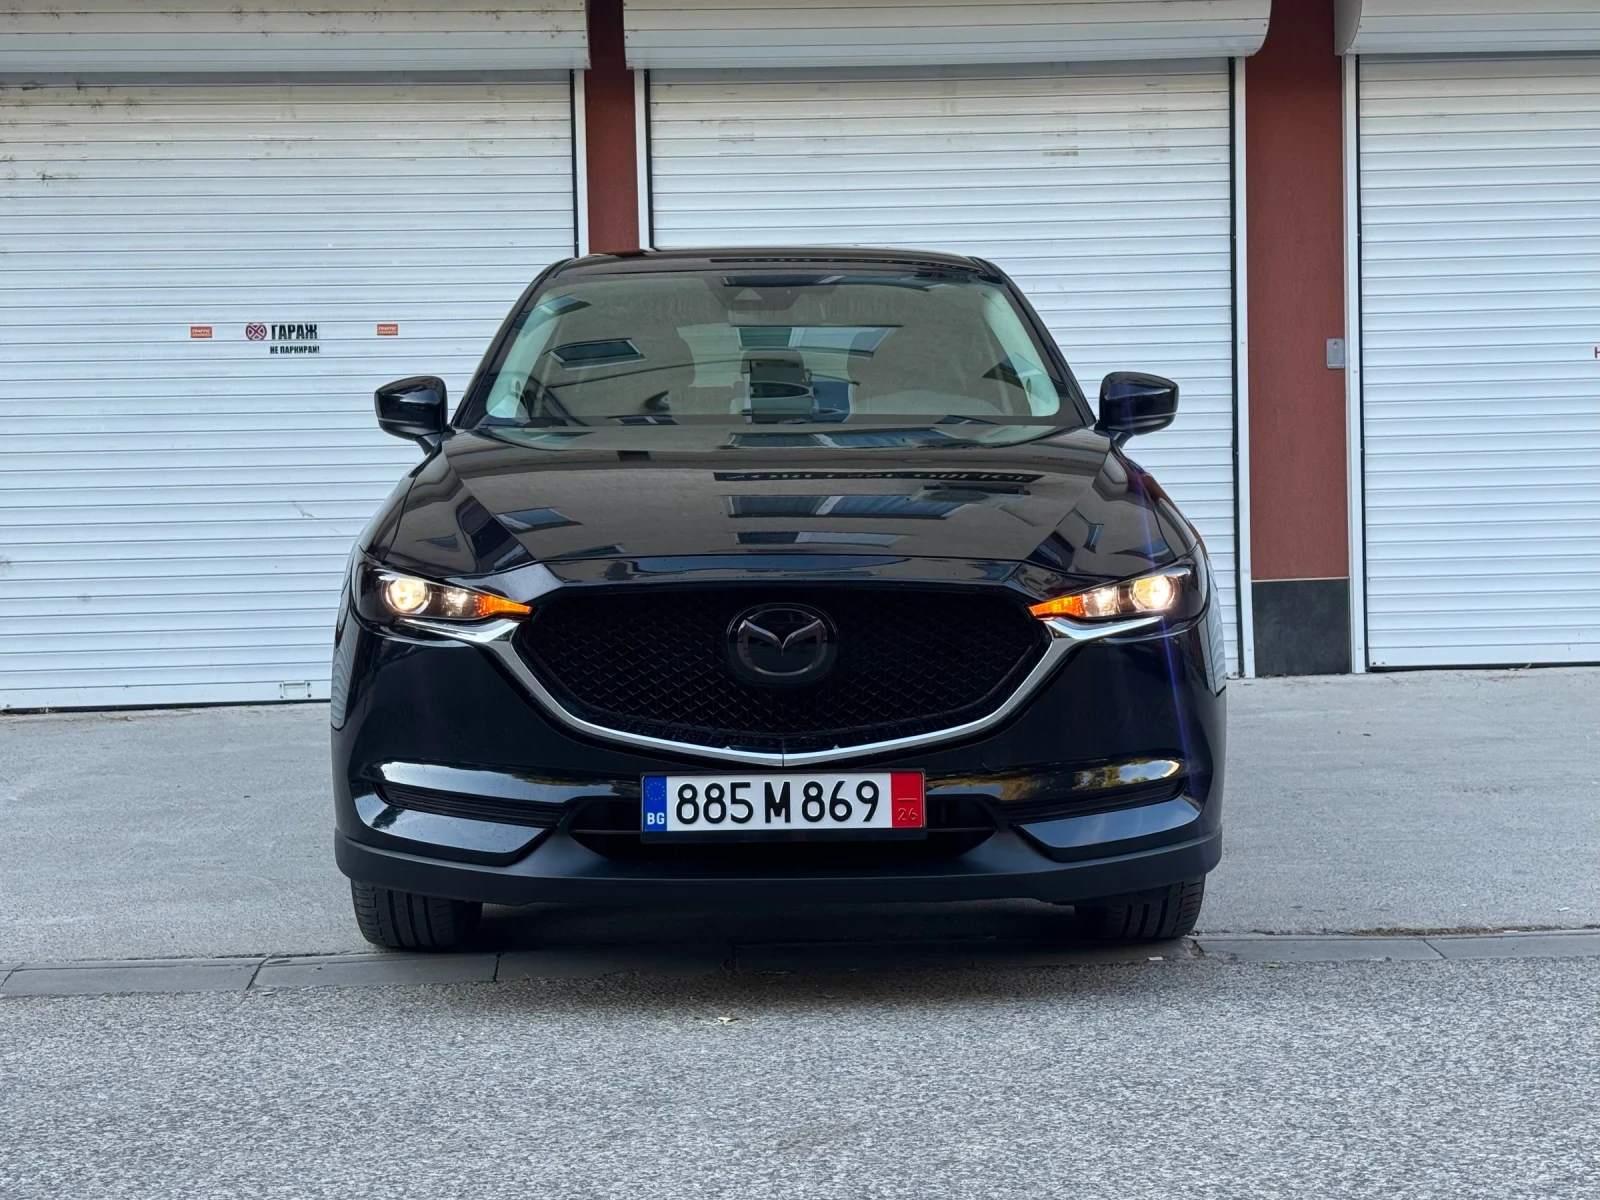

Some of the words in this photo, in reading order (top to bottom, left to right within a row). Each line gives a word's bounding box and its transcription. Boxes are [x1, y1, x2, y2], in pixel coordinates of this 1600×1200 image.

[271, 324, 318, 340] ГАРАЖ
[270, 346, 279, 354] НЕ
[676, 781, 754, 825] 885
[764, 781, 791, 824] M
[801, 780, 880, 823] 869
[647, 812, 665, 825] BG
[898, 807, 918, 821] 26
